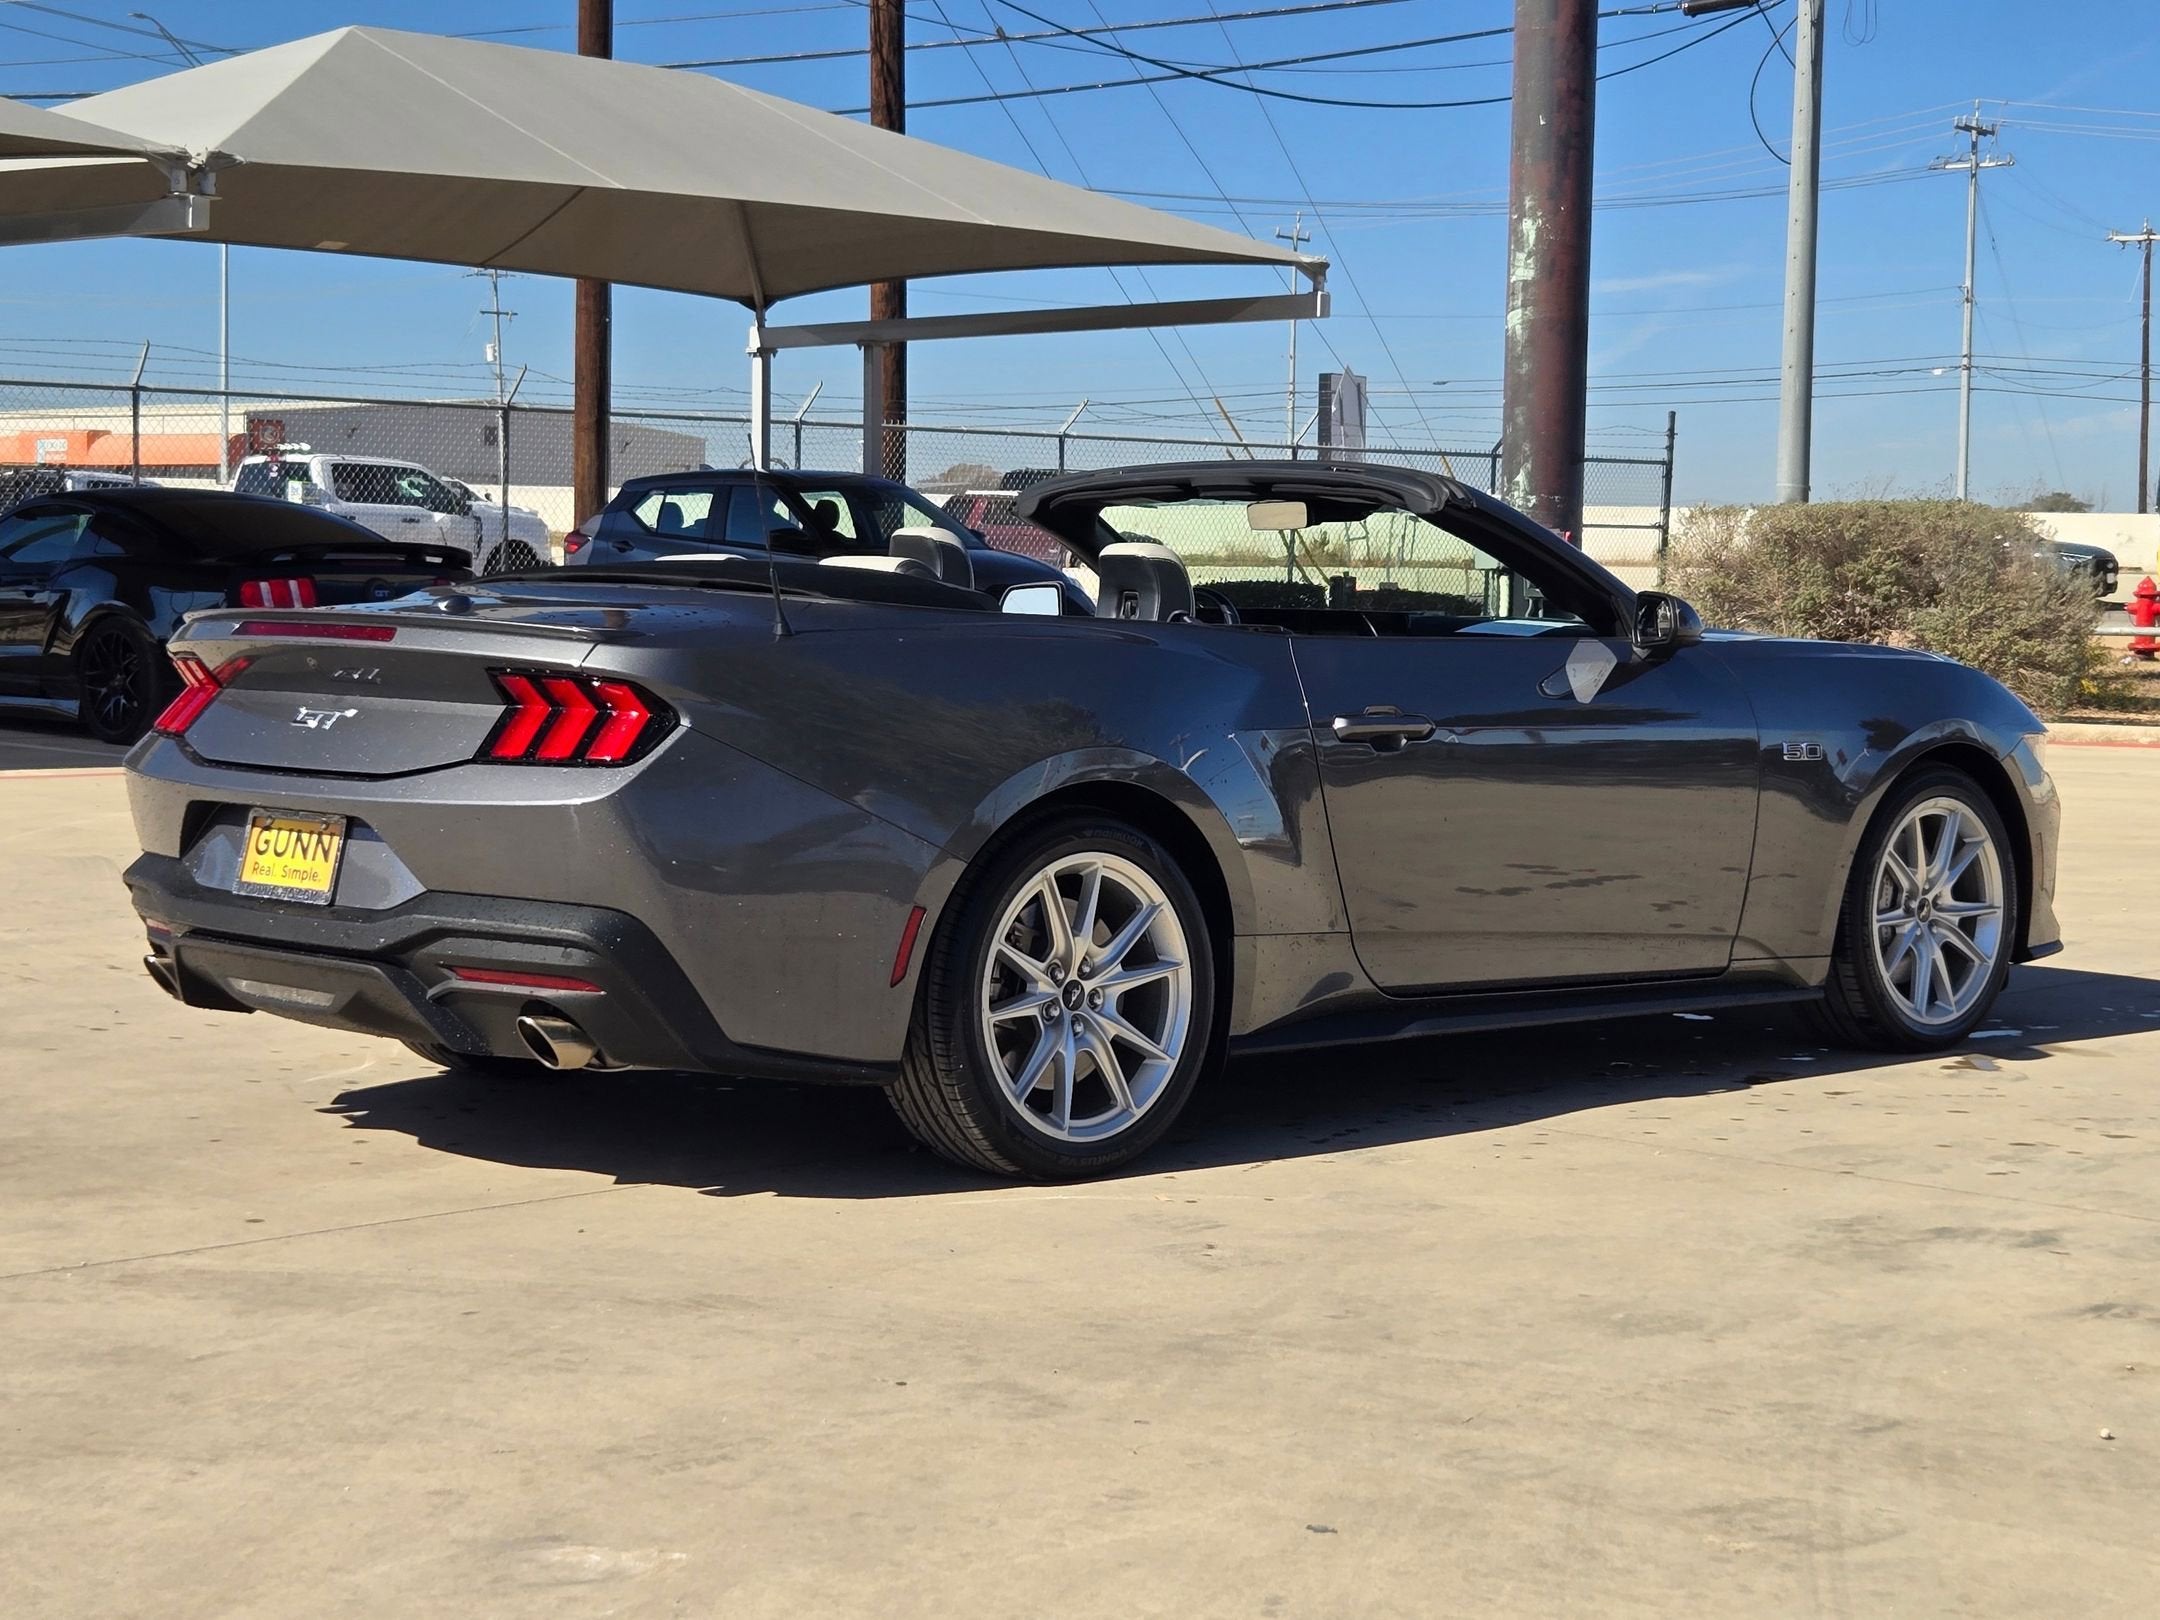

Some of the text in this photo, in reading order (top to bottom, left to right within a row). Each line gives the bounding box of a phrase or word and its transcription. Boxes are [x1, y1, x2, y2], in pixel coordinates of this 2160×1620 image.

[289, 706, 359, 730] GT
[1782, 742, 1823, 761] 5.0
[255, 825, 335, 863] GUNN
[281, 864, 322, 884] Simple.
